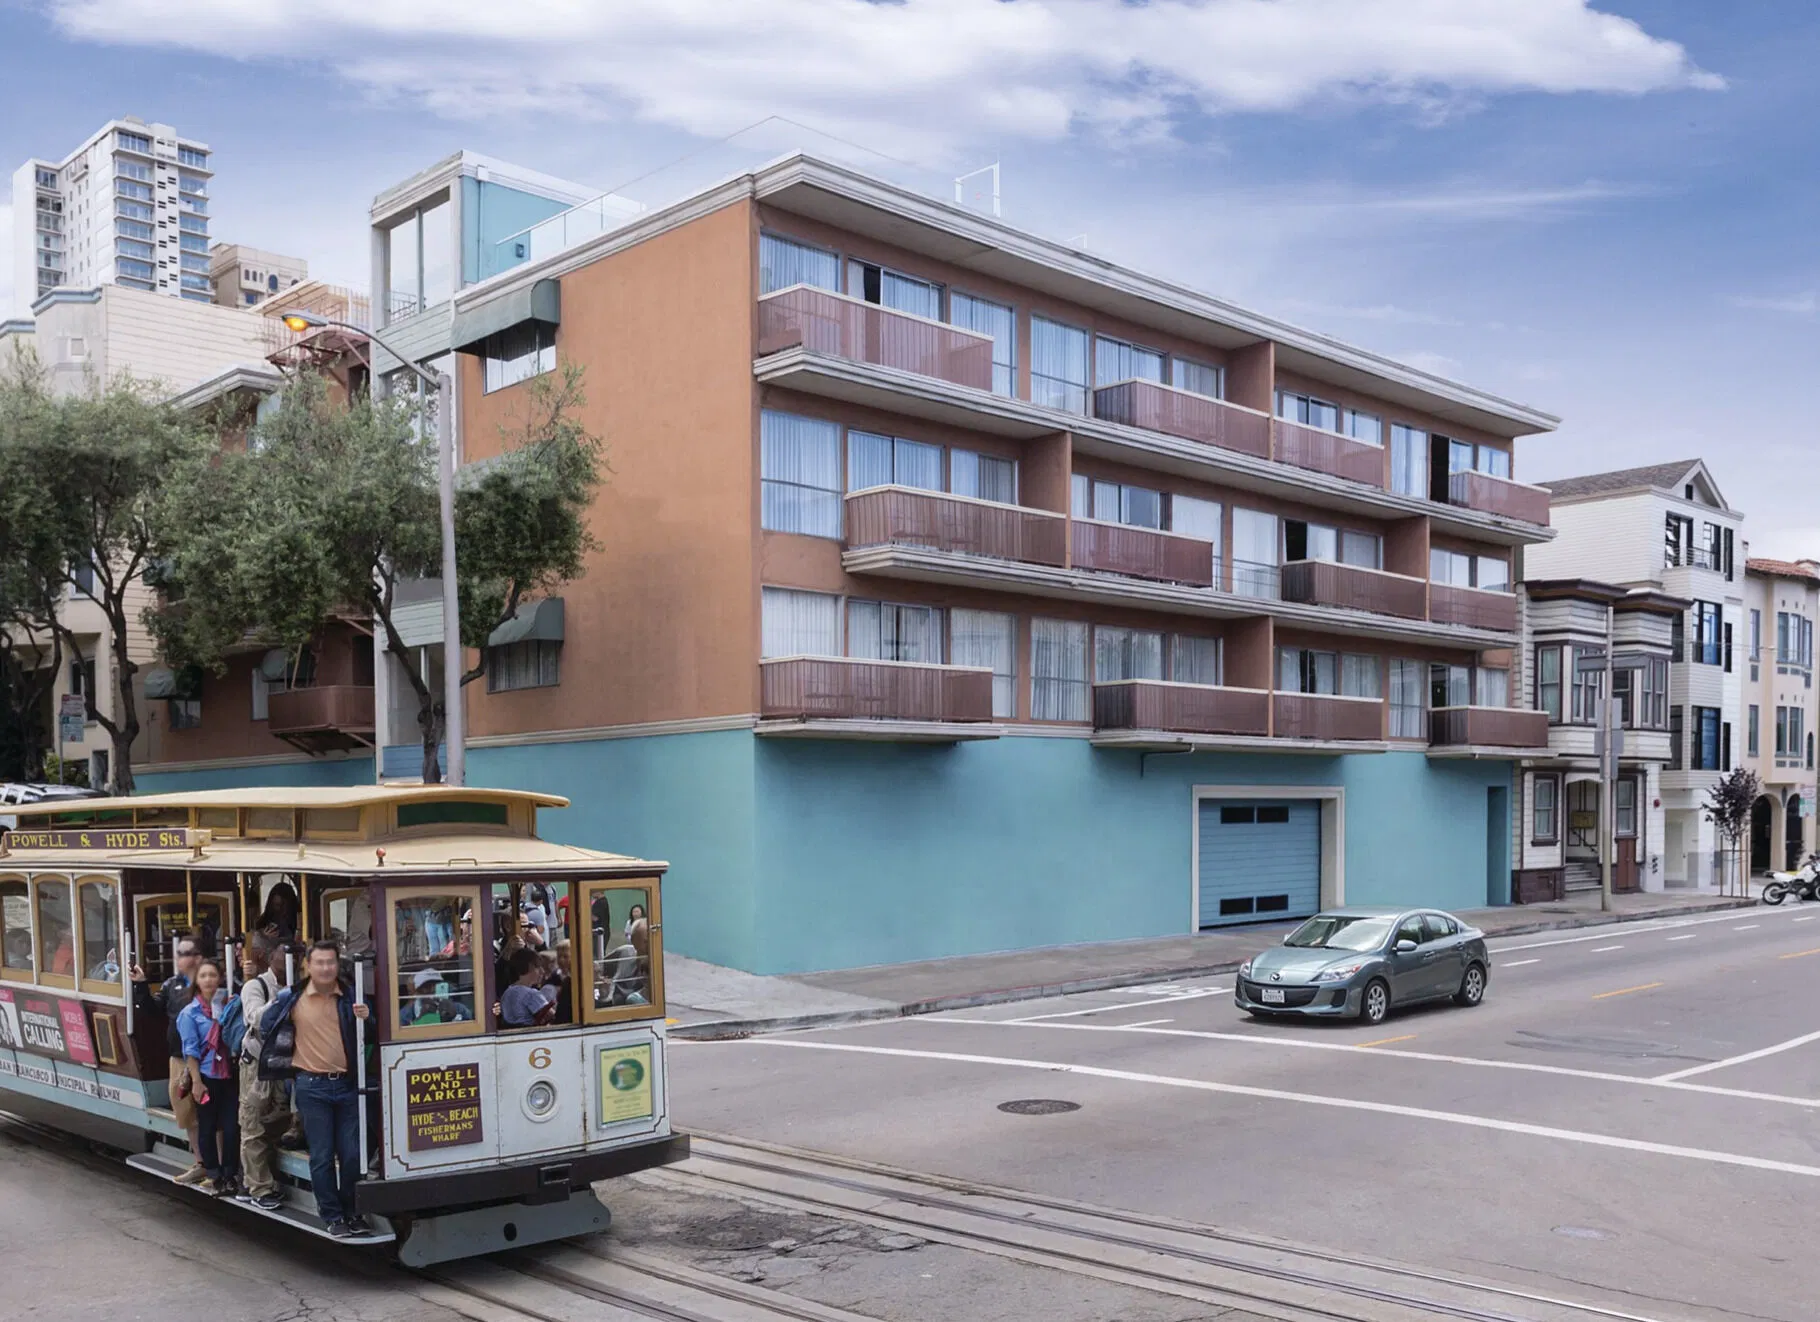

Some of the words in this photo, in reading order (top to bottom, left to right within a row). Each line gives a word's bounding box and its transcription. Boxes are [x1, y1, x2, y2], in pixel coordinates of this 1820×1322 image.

[11, 834, 68, 847] POWELL
[80, 833, 91, 847] &
[106, 833, 149, 847] HYDE
[159, 832, 183, 846] Sts.
[23, 1023, 64, 1052] CALLING
[528, 1047, 552, 1069] 6
[12, 1063, 49, 1083] FANCISCO
[411, 1069, 476, 1085] POWELL
[429, 1081, 461, 1091] AND
[410, 1087, 477, 1104] MARKET
[412, 1112, 434, 1126] HYDE
[449, 1106, 478, 1121] BEACH
[418, 1121, 473, 1136] FISHERMANS
[432, 1131, 460, 1142] WHARF
